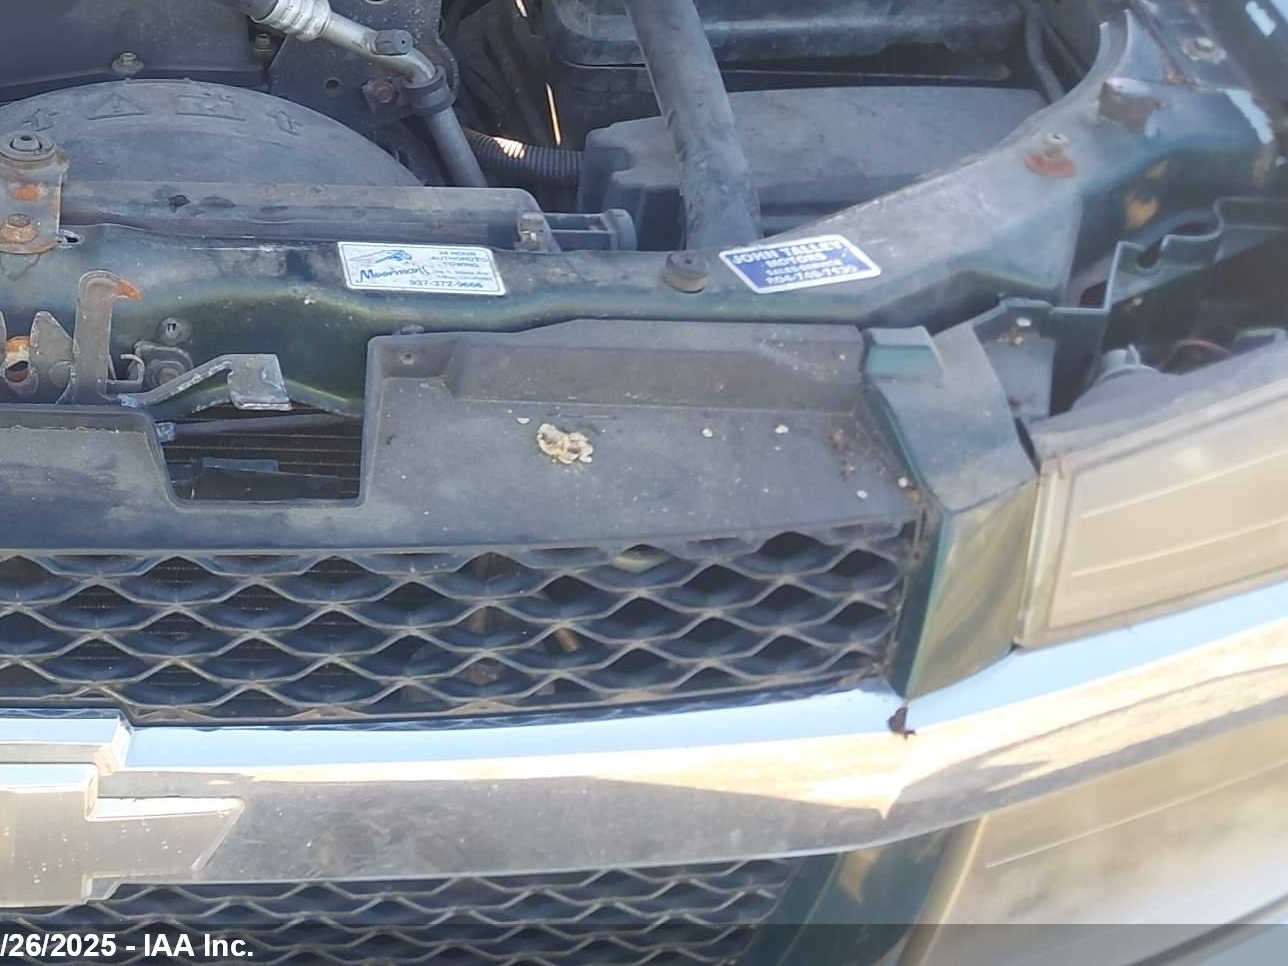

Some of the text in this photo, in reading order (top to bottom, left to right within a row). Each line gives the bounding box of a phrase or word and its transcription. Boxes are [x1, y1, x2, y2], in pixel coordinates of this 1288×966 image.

[732, 240, 843, 265] JOHN TALLEY
[765, 252, 828, 268] MOTORS
